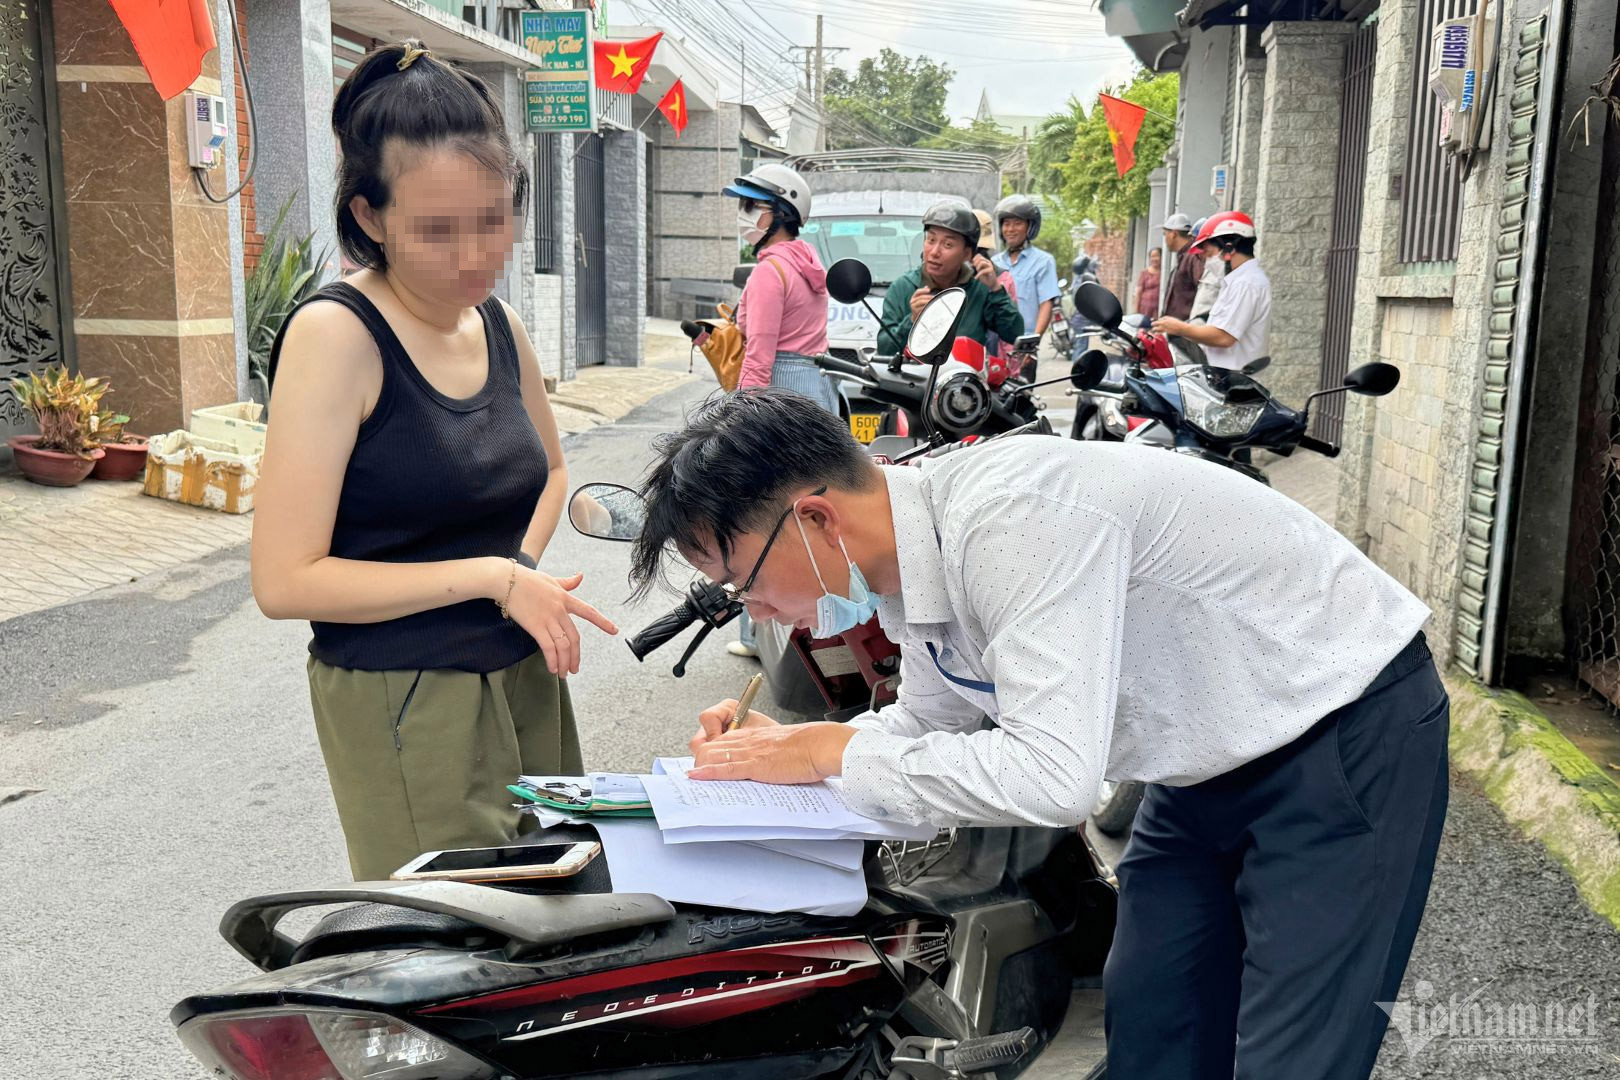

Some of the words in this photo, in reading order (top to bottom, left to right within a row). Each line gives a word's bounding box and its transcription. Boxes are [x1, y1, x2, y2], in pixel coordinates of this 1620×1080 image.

[526, 16, 552, 32] NHÀ
[555, 17, 581, 32] MAY
[908, 937, 945, 953] AUTOMATIC
